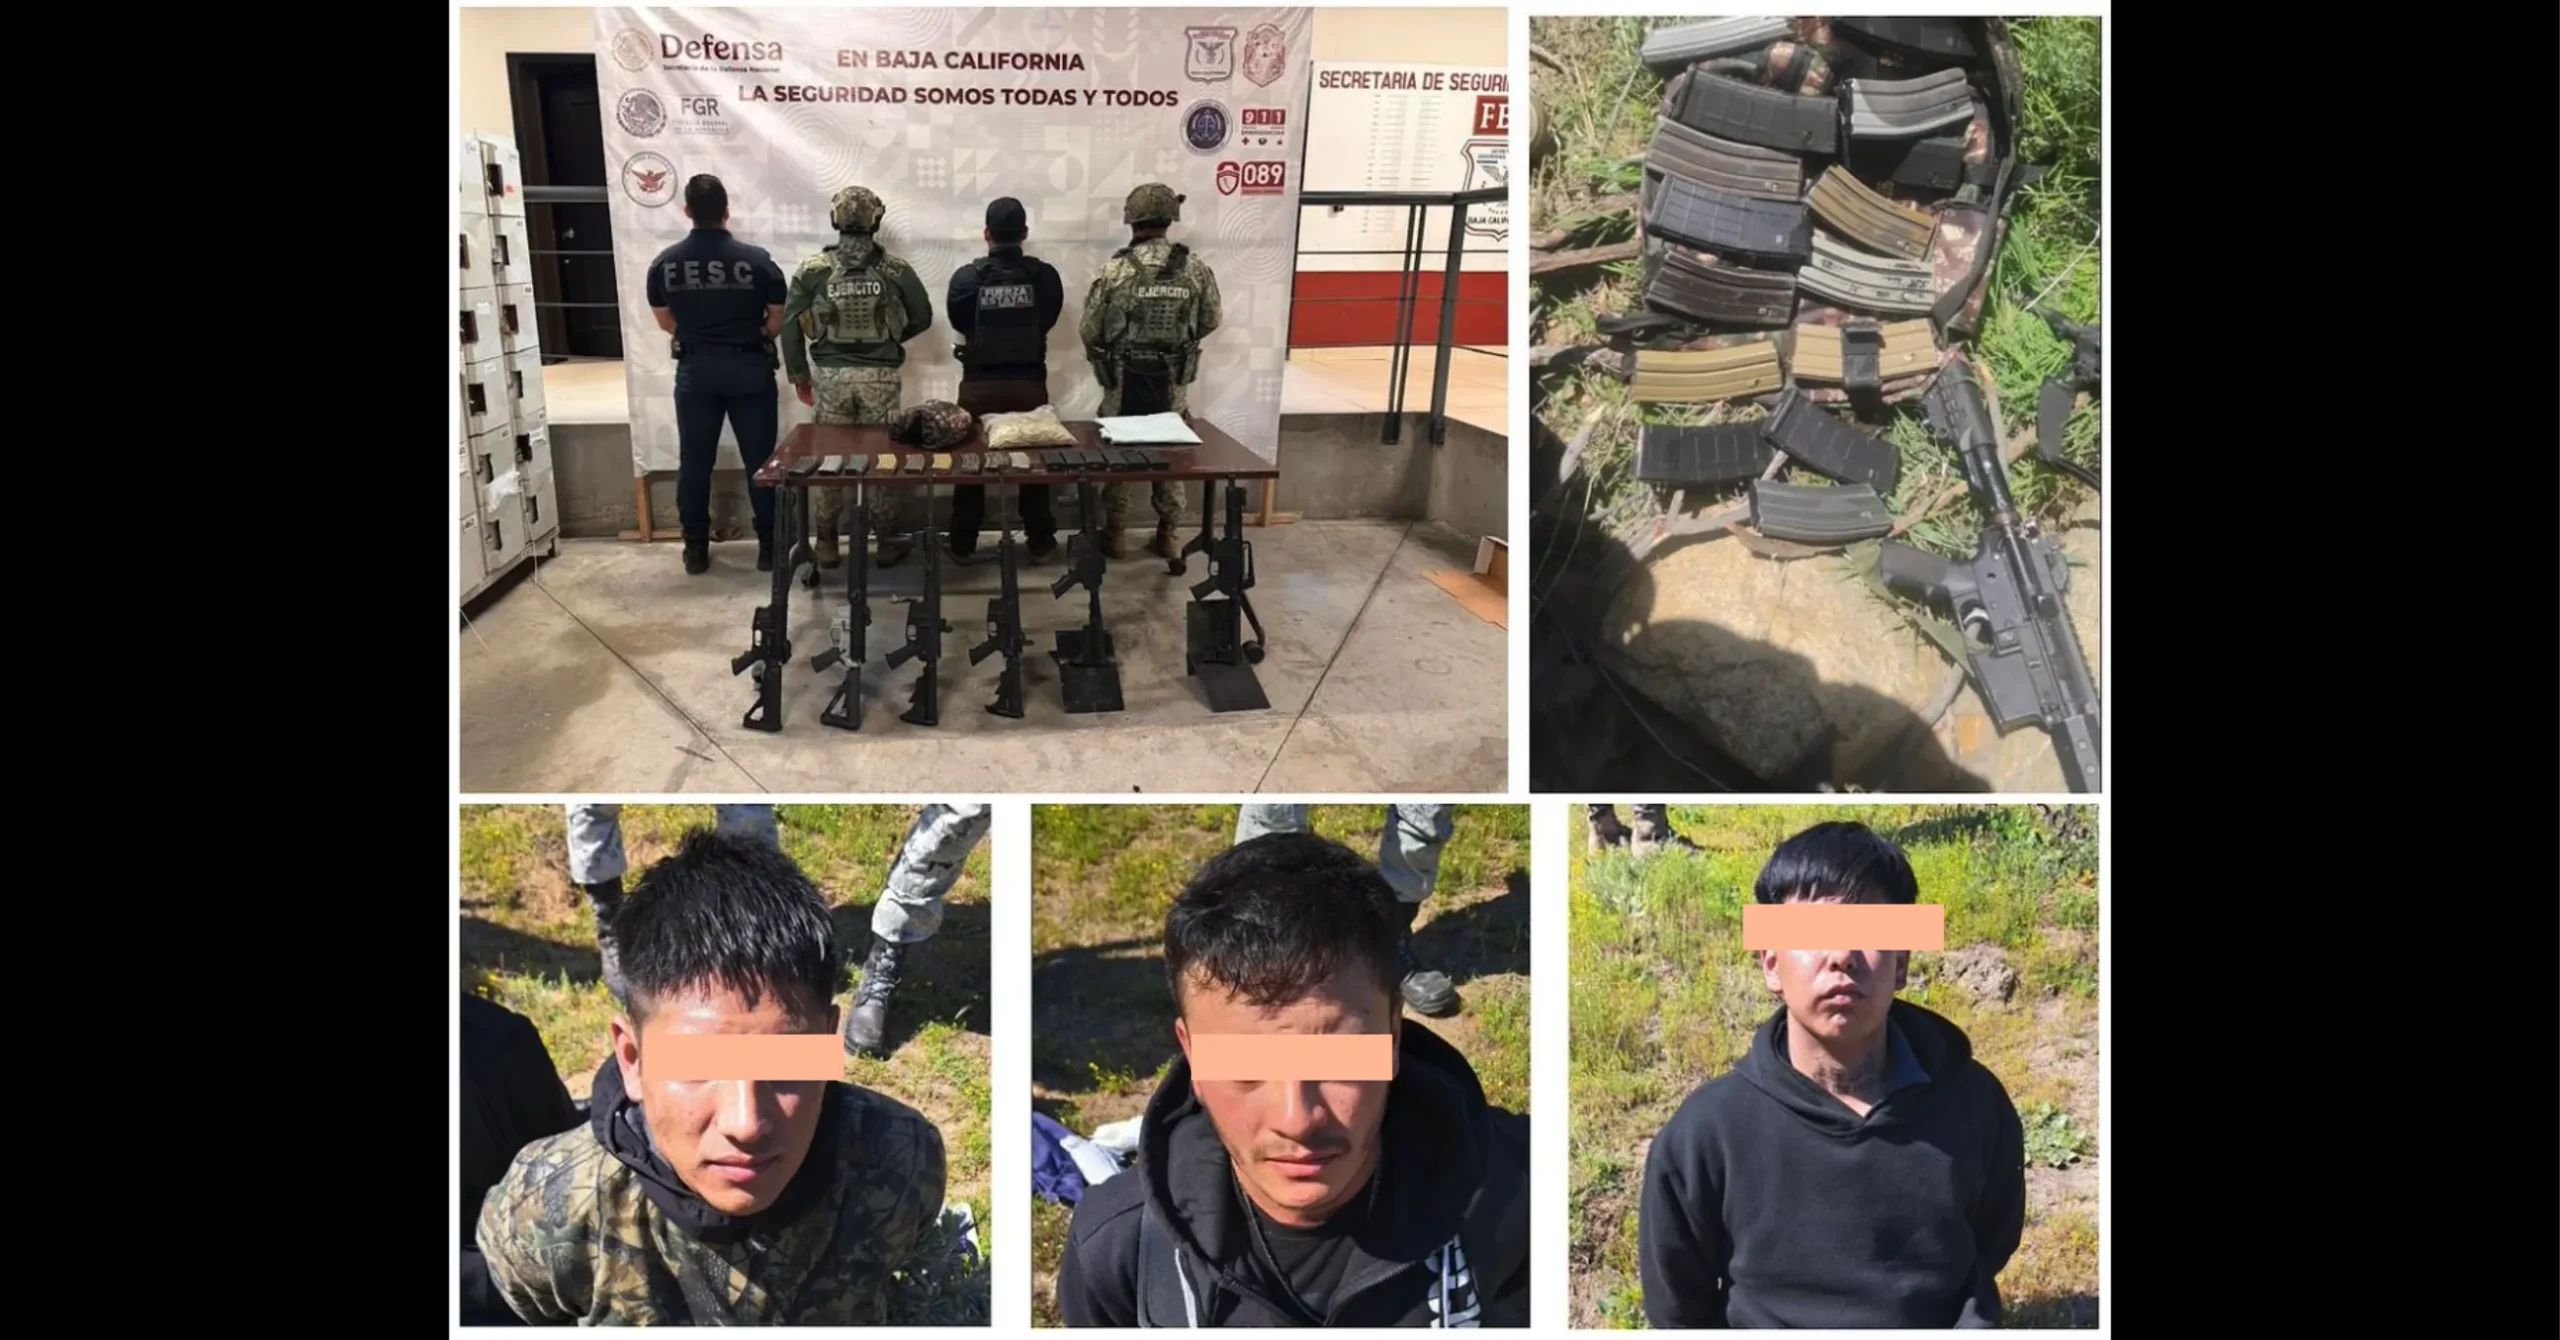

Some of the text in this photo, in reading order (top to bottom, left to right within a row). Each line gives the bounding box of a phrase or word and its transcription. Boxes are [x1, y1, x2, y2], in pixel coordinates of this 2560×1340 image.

[660, 33, 783, 61] Defensa
[836, 50, 1086, 72] EN BAJA CALIFORNIA
[1319, 70, 1417, 90] SECRETARIA
[1422, 73, 1445, 91] DE
[681, 98, 720, 116] FGR
[738, 85, 1179, 107] LA SEGURIDAD SOMOS TODAS Y TODOS
[1245, 111, 1283, 123] 911
[1243, 163, 1283, 185] 089
[663, 260, 754, 290] FESC
